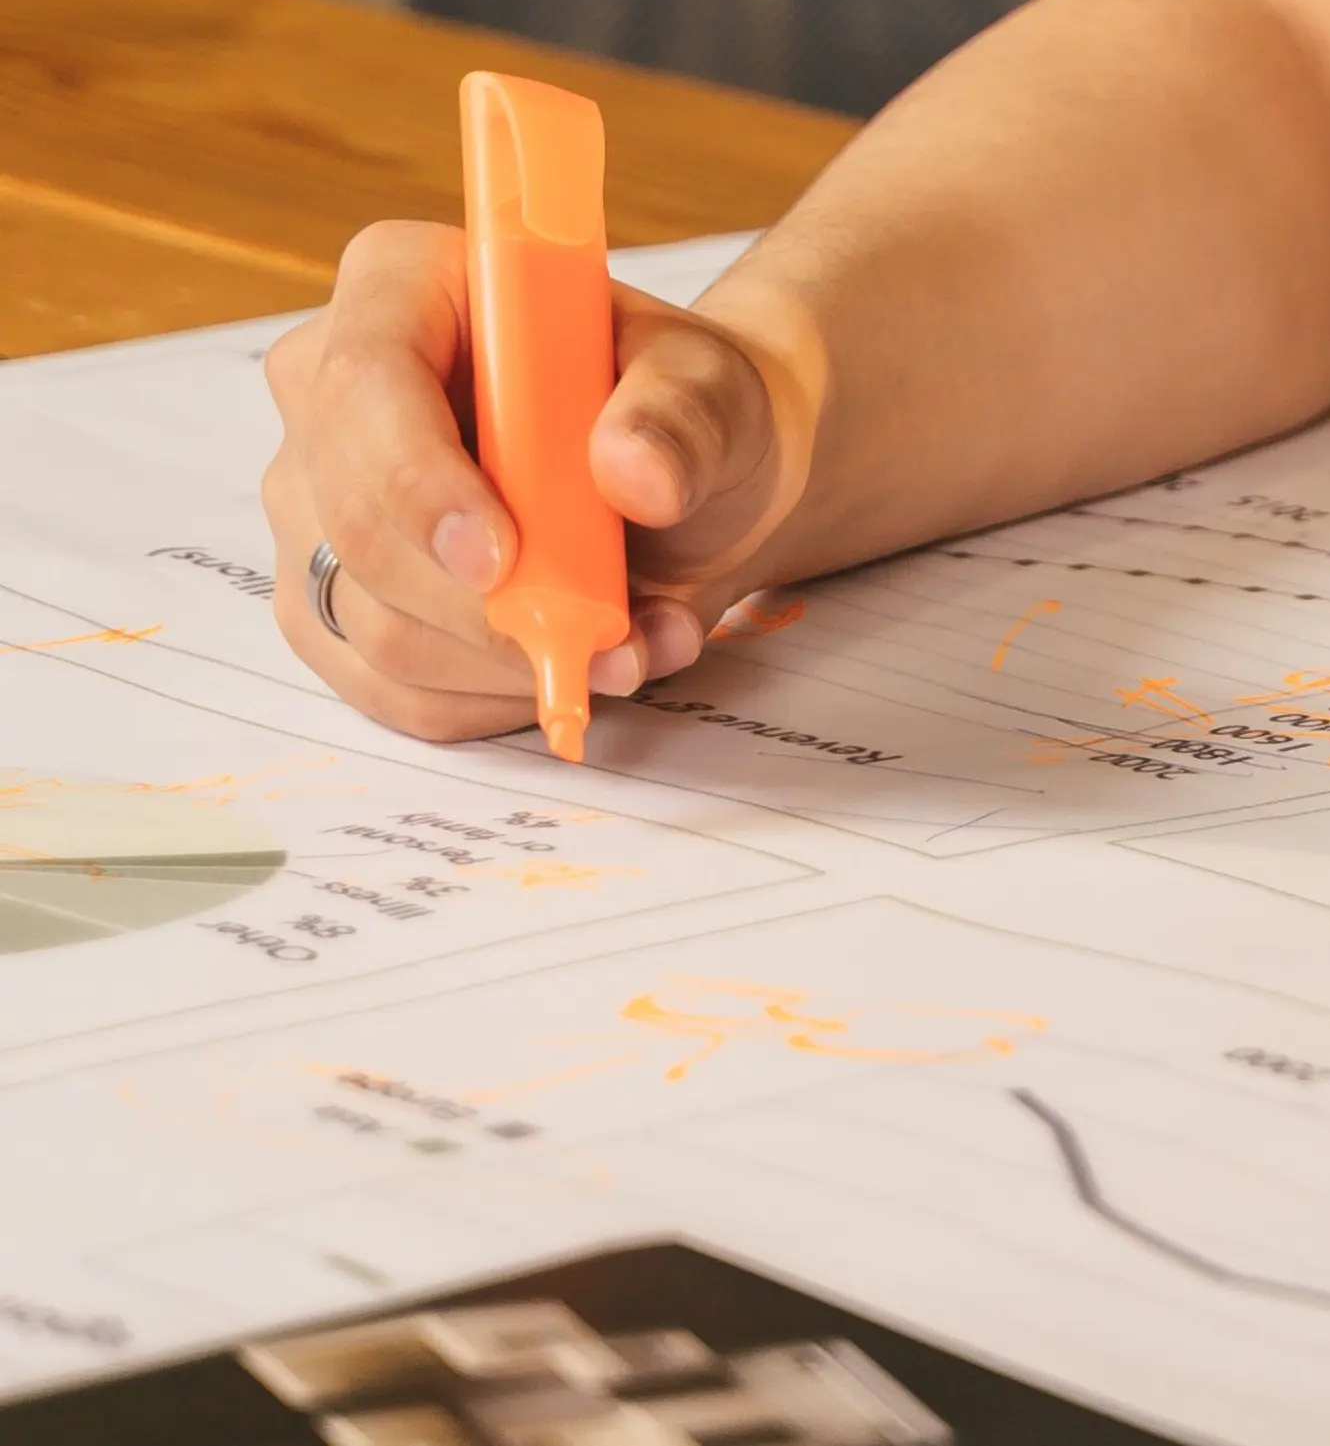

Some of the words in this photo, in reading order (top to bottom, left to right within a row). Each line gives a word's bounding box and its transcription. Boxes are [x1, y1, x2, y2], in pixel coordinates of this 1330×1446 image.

[144, 544, 275, 599] llions)
[698, 713, 904, 765] Revenue
[1150, 737, 1254, 766] 1800
[1209, 724, 1314, 754] 1600
[1085, 749, 1200, 784] 2000
[387, 811, 501, 841] family
[493, 810, 559, 829] 4%
[319, 824, 494, 865] Personal
[503, 839, 556, 851] or
[311, 880, 434, 920] Illness
[394, 874, 470, 897] 3%
[284, 912, 357, 938] 8%
[194, 920, 318, 961] Other
